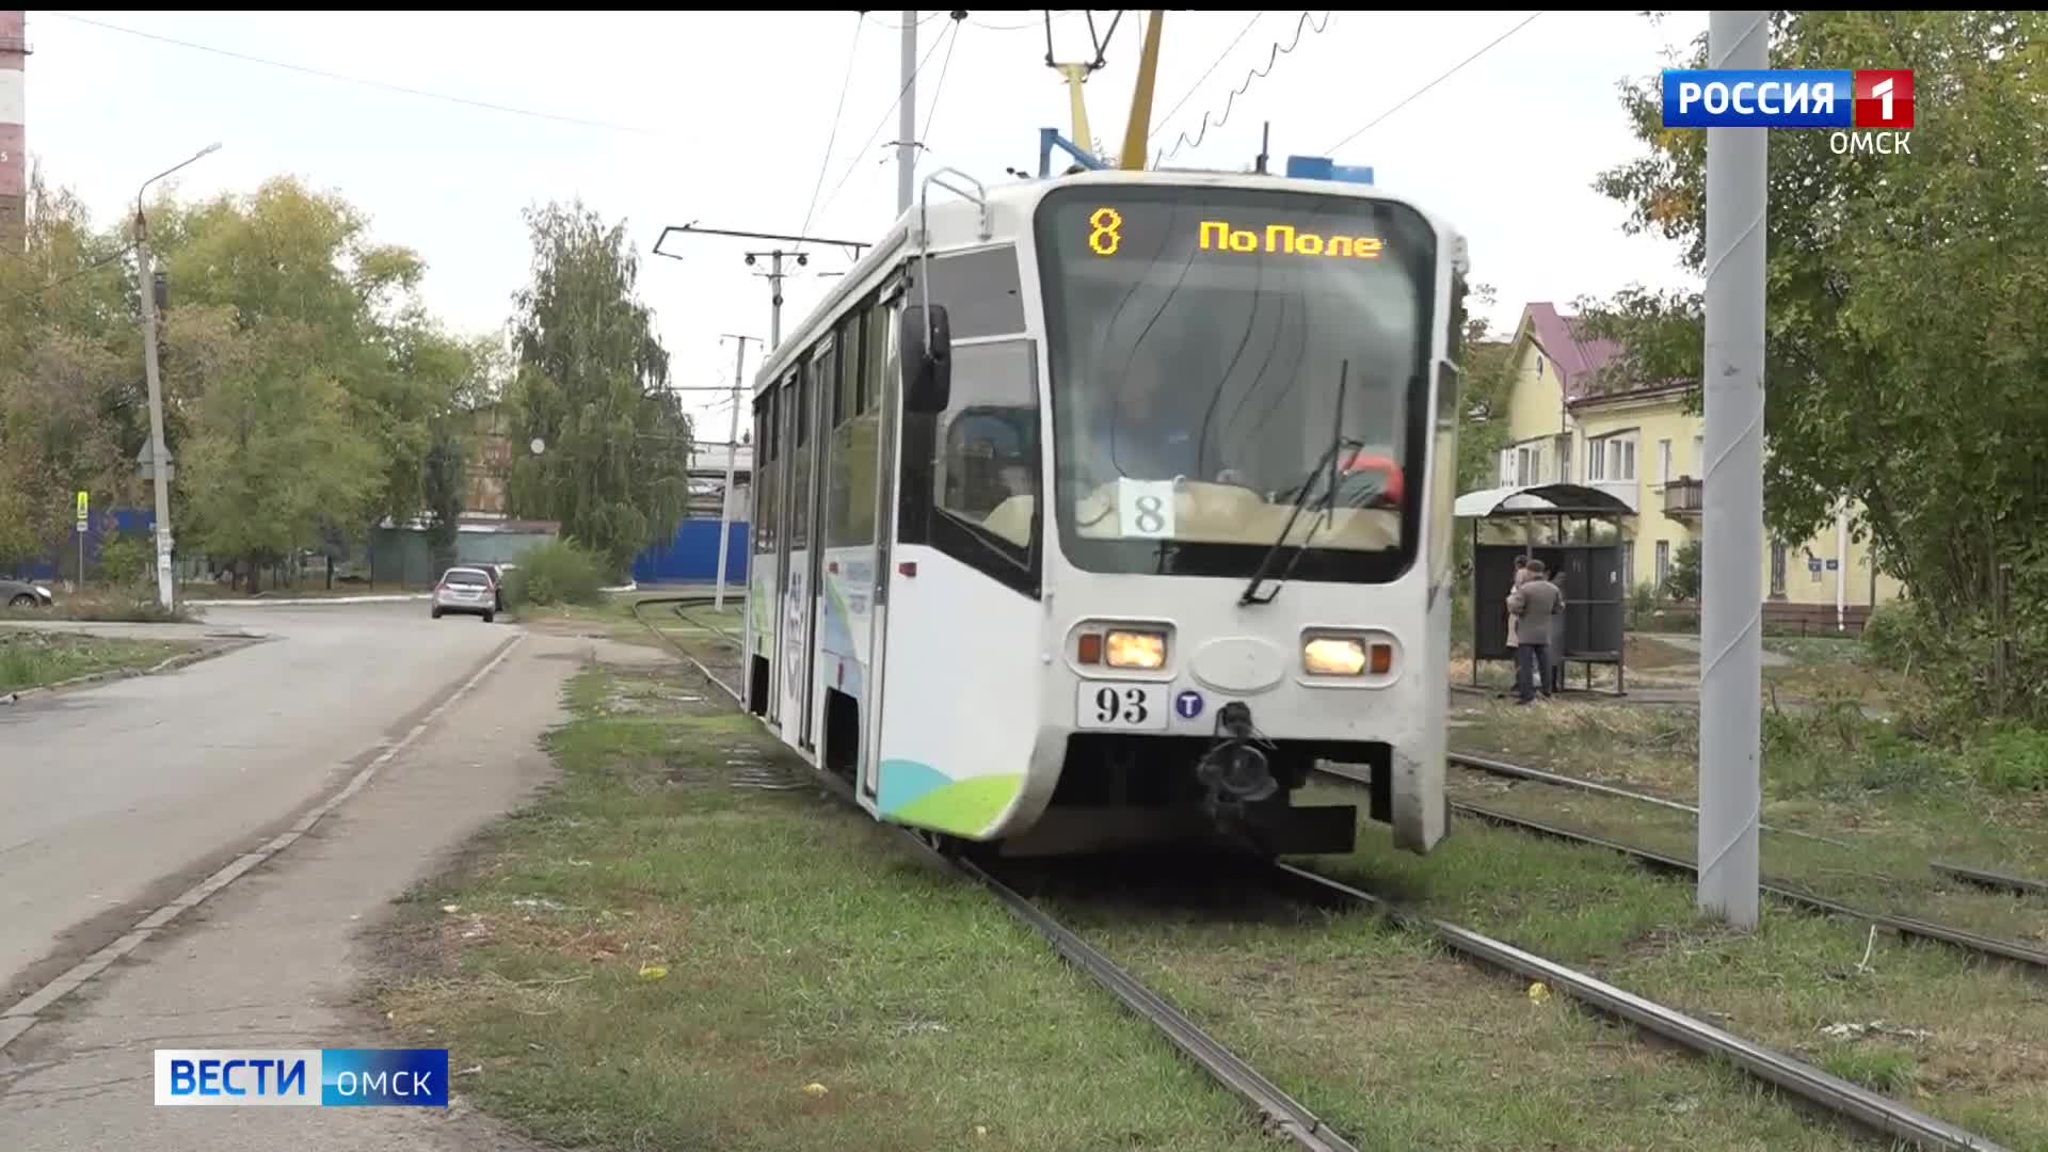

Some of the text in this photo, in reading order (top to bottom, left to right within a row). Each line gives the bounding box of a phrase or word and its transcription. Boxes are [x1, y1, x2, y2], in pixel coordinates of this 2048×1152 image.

[1088, 207, 1123, 256] 8
[1199, 220, 1384, 258] По Поле
[1135, 495, 1165, 533] 8
[1095, 687, 1149, 724] 93
